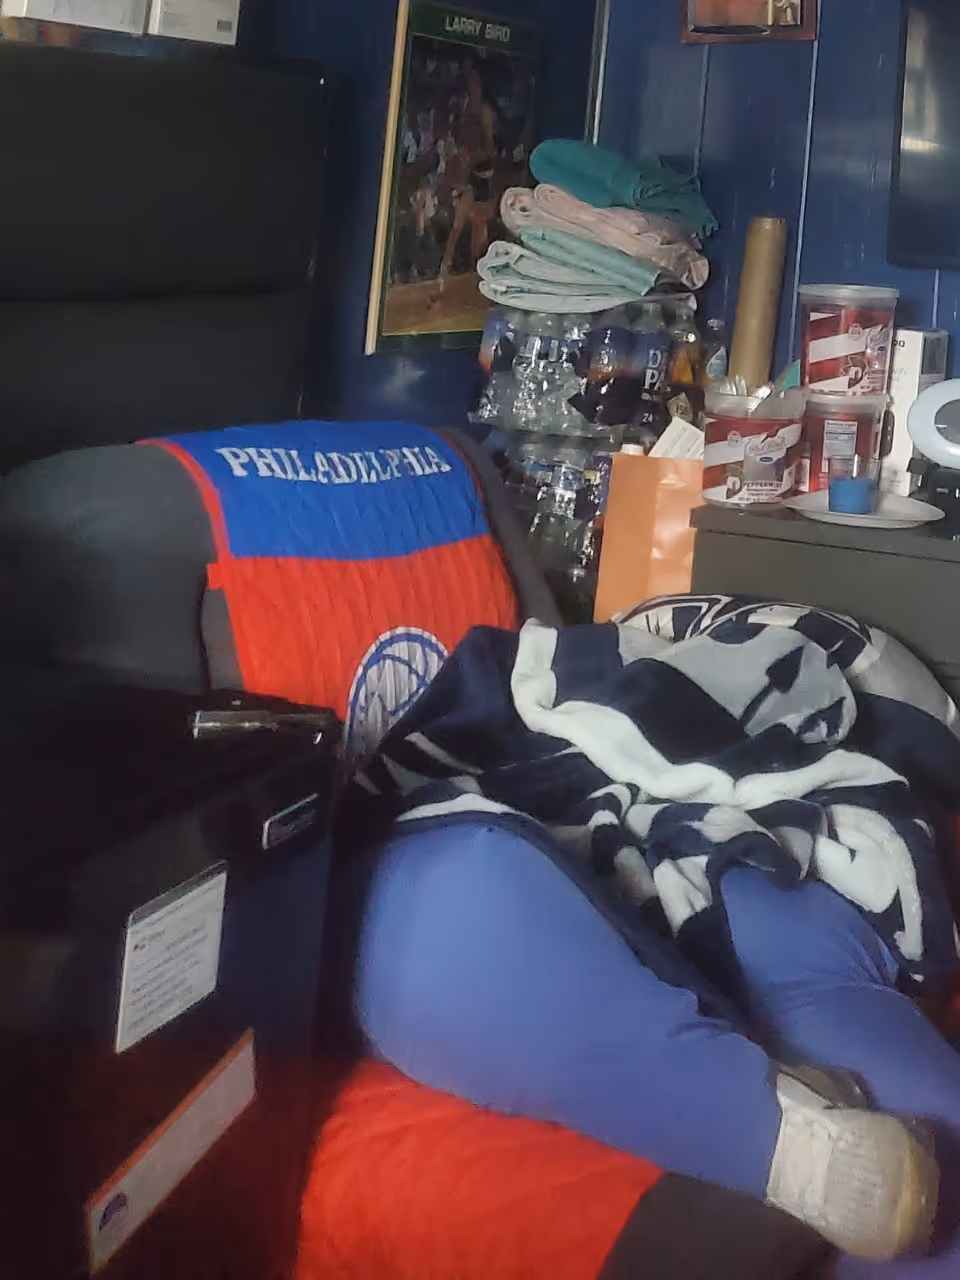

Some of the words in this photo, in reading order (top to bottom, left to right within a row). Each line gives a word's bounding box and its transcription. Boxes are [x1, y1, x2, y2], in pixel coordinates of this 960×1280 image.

[445, 15, 482, 36] LARRY
[485, 23, 511, 42] BIRD
[215, 446, 452, 485] PHILADELPHIA
